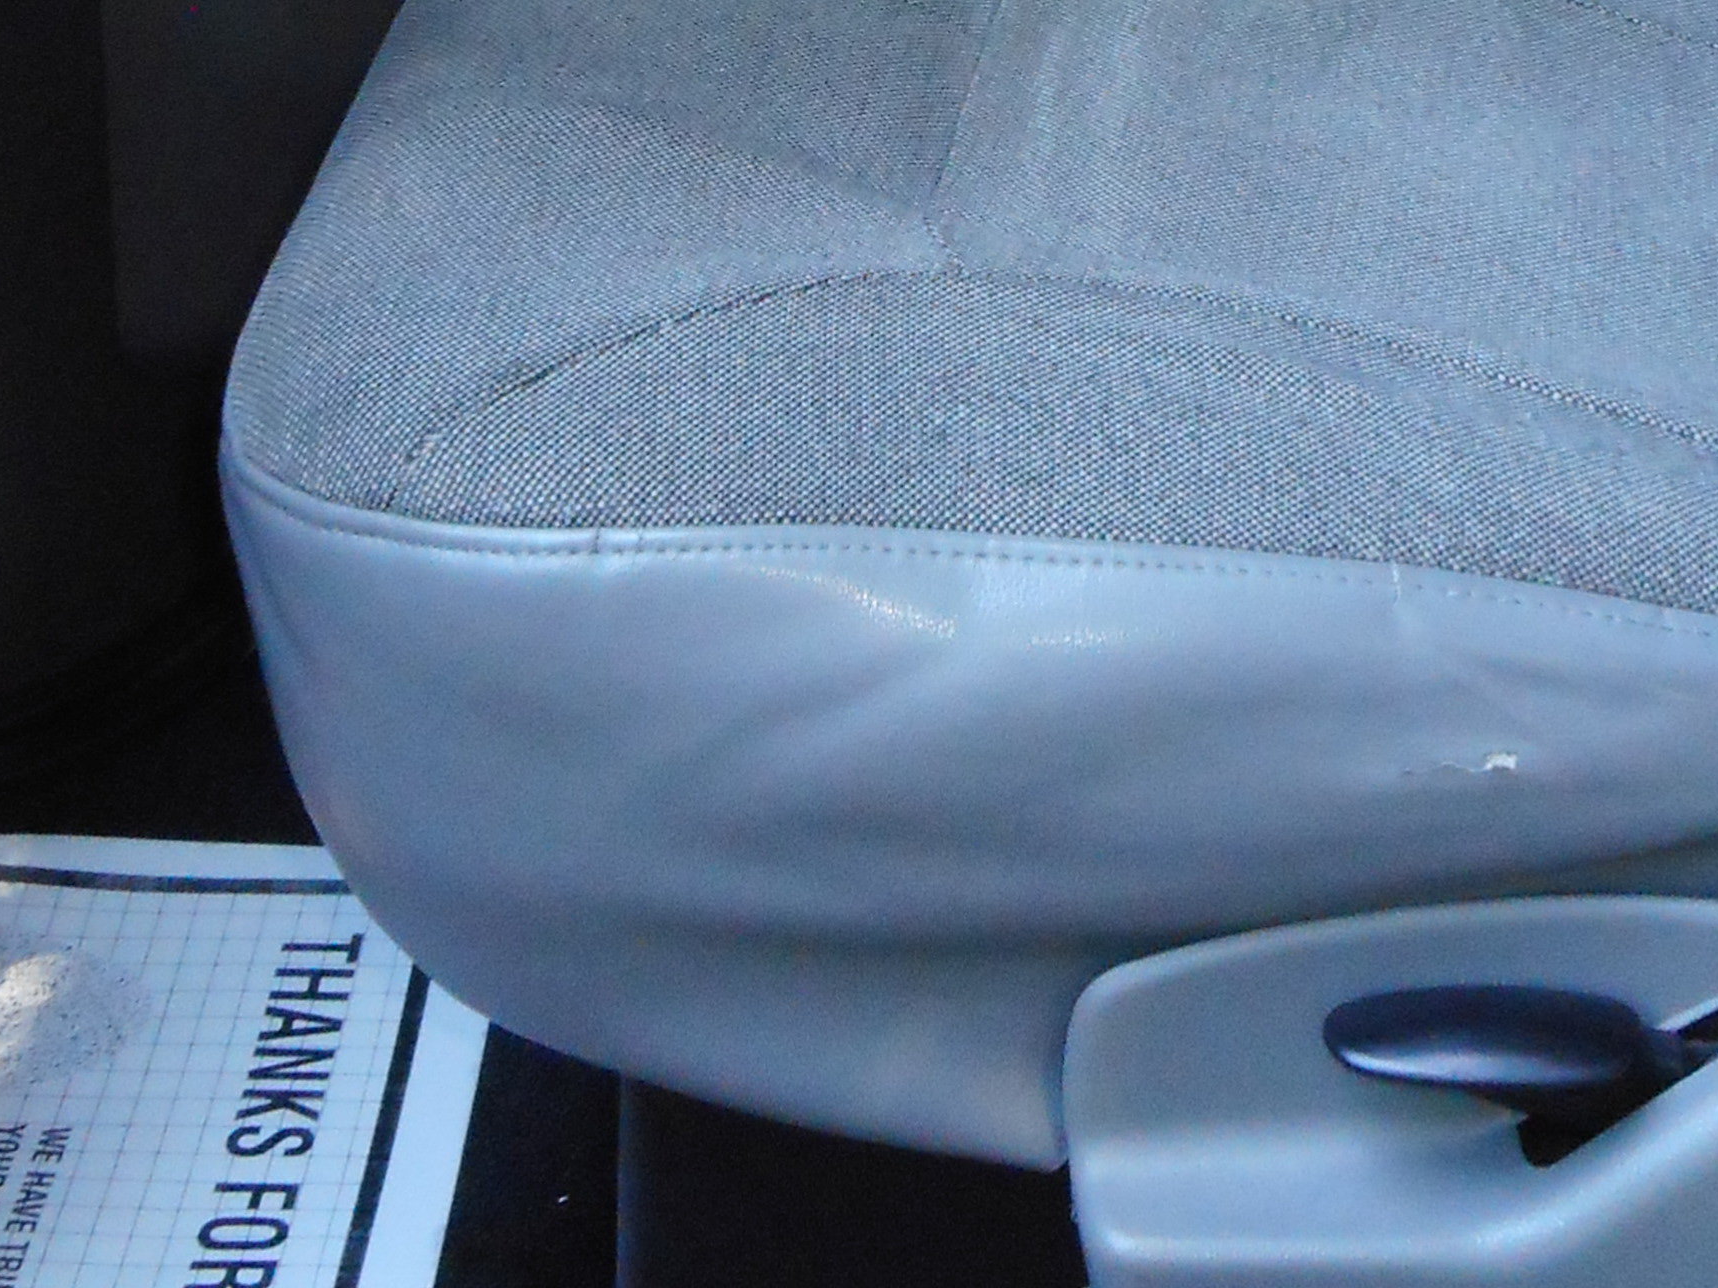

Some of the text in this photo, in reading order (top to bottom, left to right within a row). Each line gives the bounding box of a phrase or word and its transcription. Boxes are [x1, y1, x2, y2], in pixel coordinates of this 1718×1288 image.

[183, 932, 366, 1288] THANKS FOR
[31, 1127, 73, 1164] WE
[4, 1171, 57, 1234] HAVE
